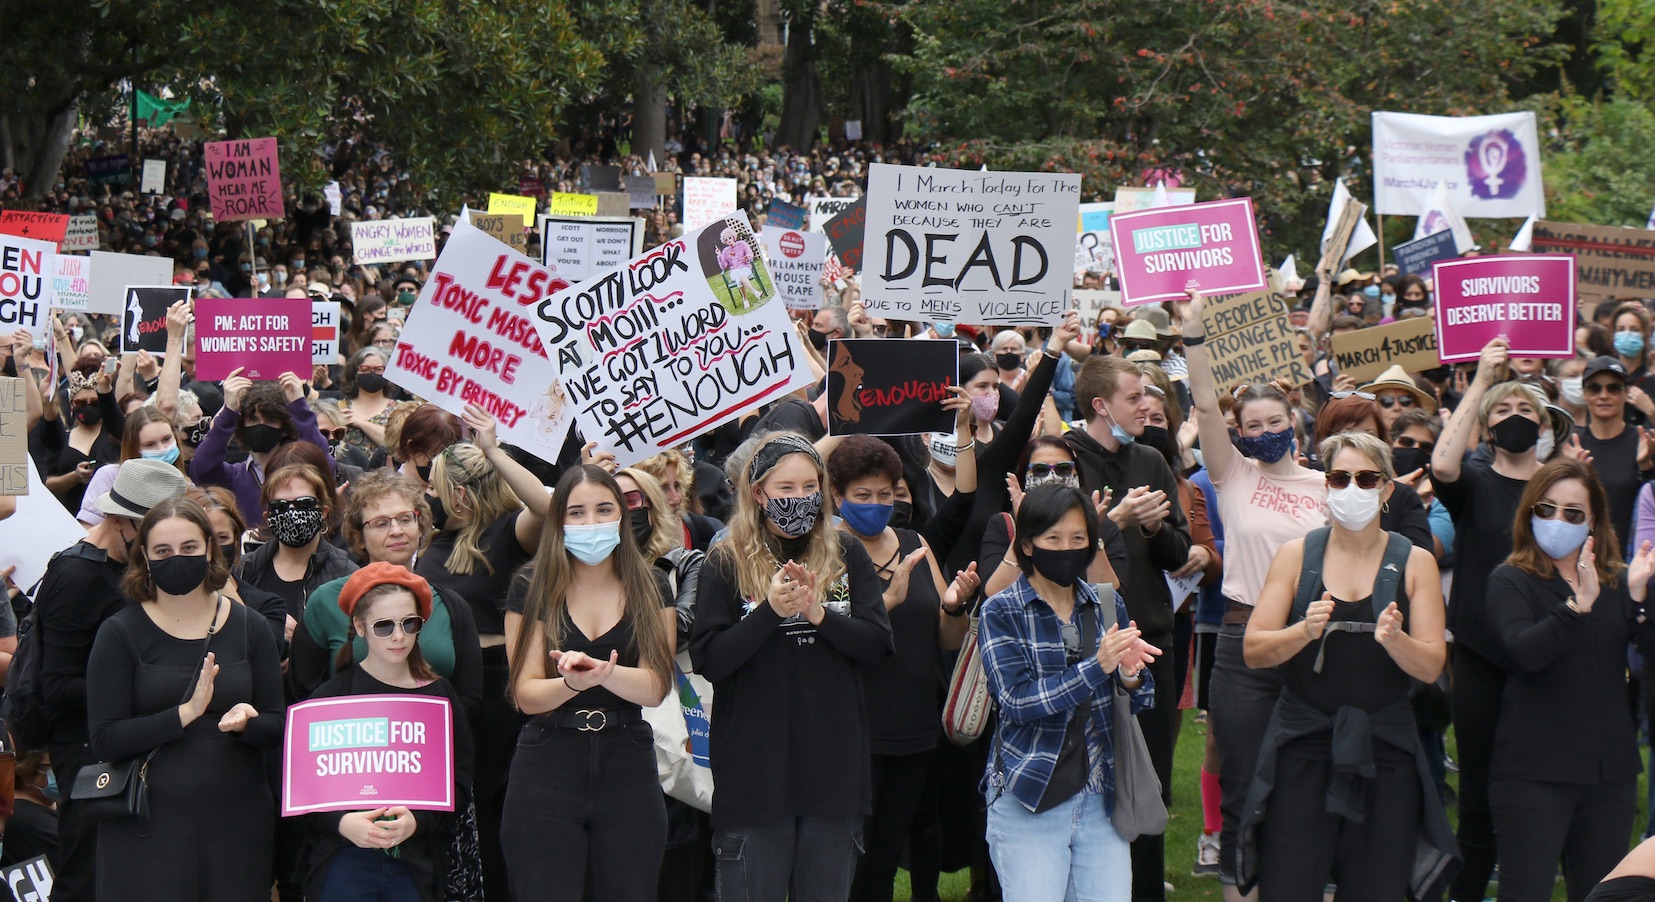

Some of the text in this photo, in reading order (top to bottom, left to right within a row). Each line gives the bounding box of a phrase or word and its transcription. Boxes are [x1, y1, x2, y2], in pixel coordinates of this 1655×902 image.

[226, 143, 230, 157] I
[234, 142, 251, 157] AM
[1382, 139, 1456, 152] Victorian Women
[210, 157, 271, 180] WOMAN
[1381, 153, 1459, 166] Parliamentarians
[218, 181, 267, 196] HEAR ME
[897, 173, 1078, 197] I March Today For The
[1381, 177, 1458, 190] #March4Juice
[225, 196, 269, 215] ROAR
[493, 199, 527, 209] ENOUGH
[586, 198, 592, 208] 4
[815, 201, 854, 214] MARC
[894, 199, 1044, 213] WOMEN WHO CAN'T
[355, 223, 432, 240] ANGRY WOMEN
[477, 217, 503, 232] BOYS
[893, 215, 1052, 228] BECAUSE THEY ARE
[62, 235, 98, 246] OVER!
[383, 239, 402, 247] WILL
[510, 233, 522, 244] BE
[1136, 222, 1232, 252] JUSTICE FOR
[1398, 232, 1451, 257] PARDON MY
[2, 246, 42, 274] EN
[357, 242, 433, 260] CHANGE the WORLD
[880, 228, 1048, 293] DEAD
[1143, 246, 1233, 274] SURVIVORS
[1403, 246, 1440, 264] FRENCH
[59, 258, 82, 277] JUST
[774, 272, 810, 285] HOUSE
[537, 245, 688, 345] SCOTTY LOOK
[787, 285, 813, 296] RAPE
[1461, 275, 1540, 297] SURVIVORS
[60, 298, 88, 306] RIGHT
[431, 271, 489, 325] TOXIC
[864, 289, 1066, 319] DUE TO MEN'S VIOLENCE!
[0, 298, 38, 327] GH
[214, 315, 289, 331] PM: ACT FOR
[1214, 297, 1267, 333] PEOPLE
[1266, 292, 1284, 314] IS
[1446, 303, 1562, 326] DESERVE BETTER
[200, 336, 305, 352] WOMEN'S SAFETY
[565, 365, 607, 405] I'VE
[607, 338, 649, 382] GOT
[664, 302, 725, 350] WORD
[1269, 340, 1303, 363] PPL
[1336, 334, 1438, 370] MARCH 4 JUSTICE
[448, 330, 522, 385] MORE
[557, 339, 583, 375] AT
[396, 342, 527, 429] TOXIC BY BRITNEY
[581, 399, 618, 427] TO
[620, 370, 659, 406] SAY
[662, 356, 693, 381] TO
[604, 331, 794, 453] #ENOUGH
[859, 375, 953, 407] ENOUGH!
[311, 721, 426, 748] JUSTICE FOR
[316, 750, 422, 776] SURVIVORS
[0, 859, 54, 902] GH
